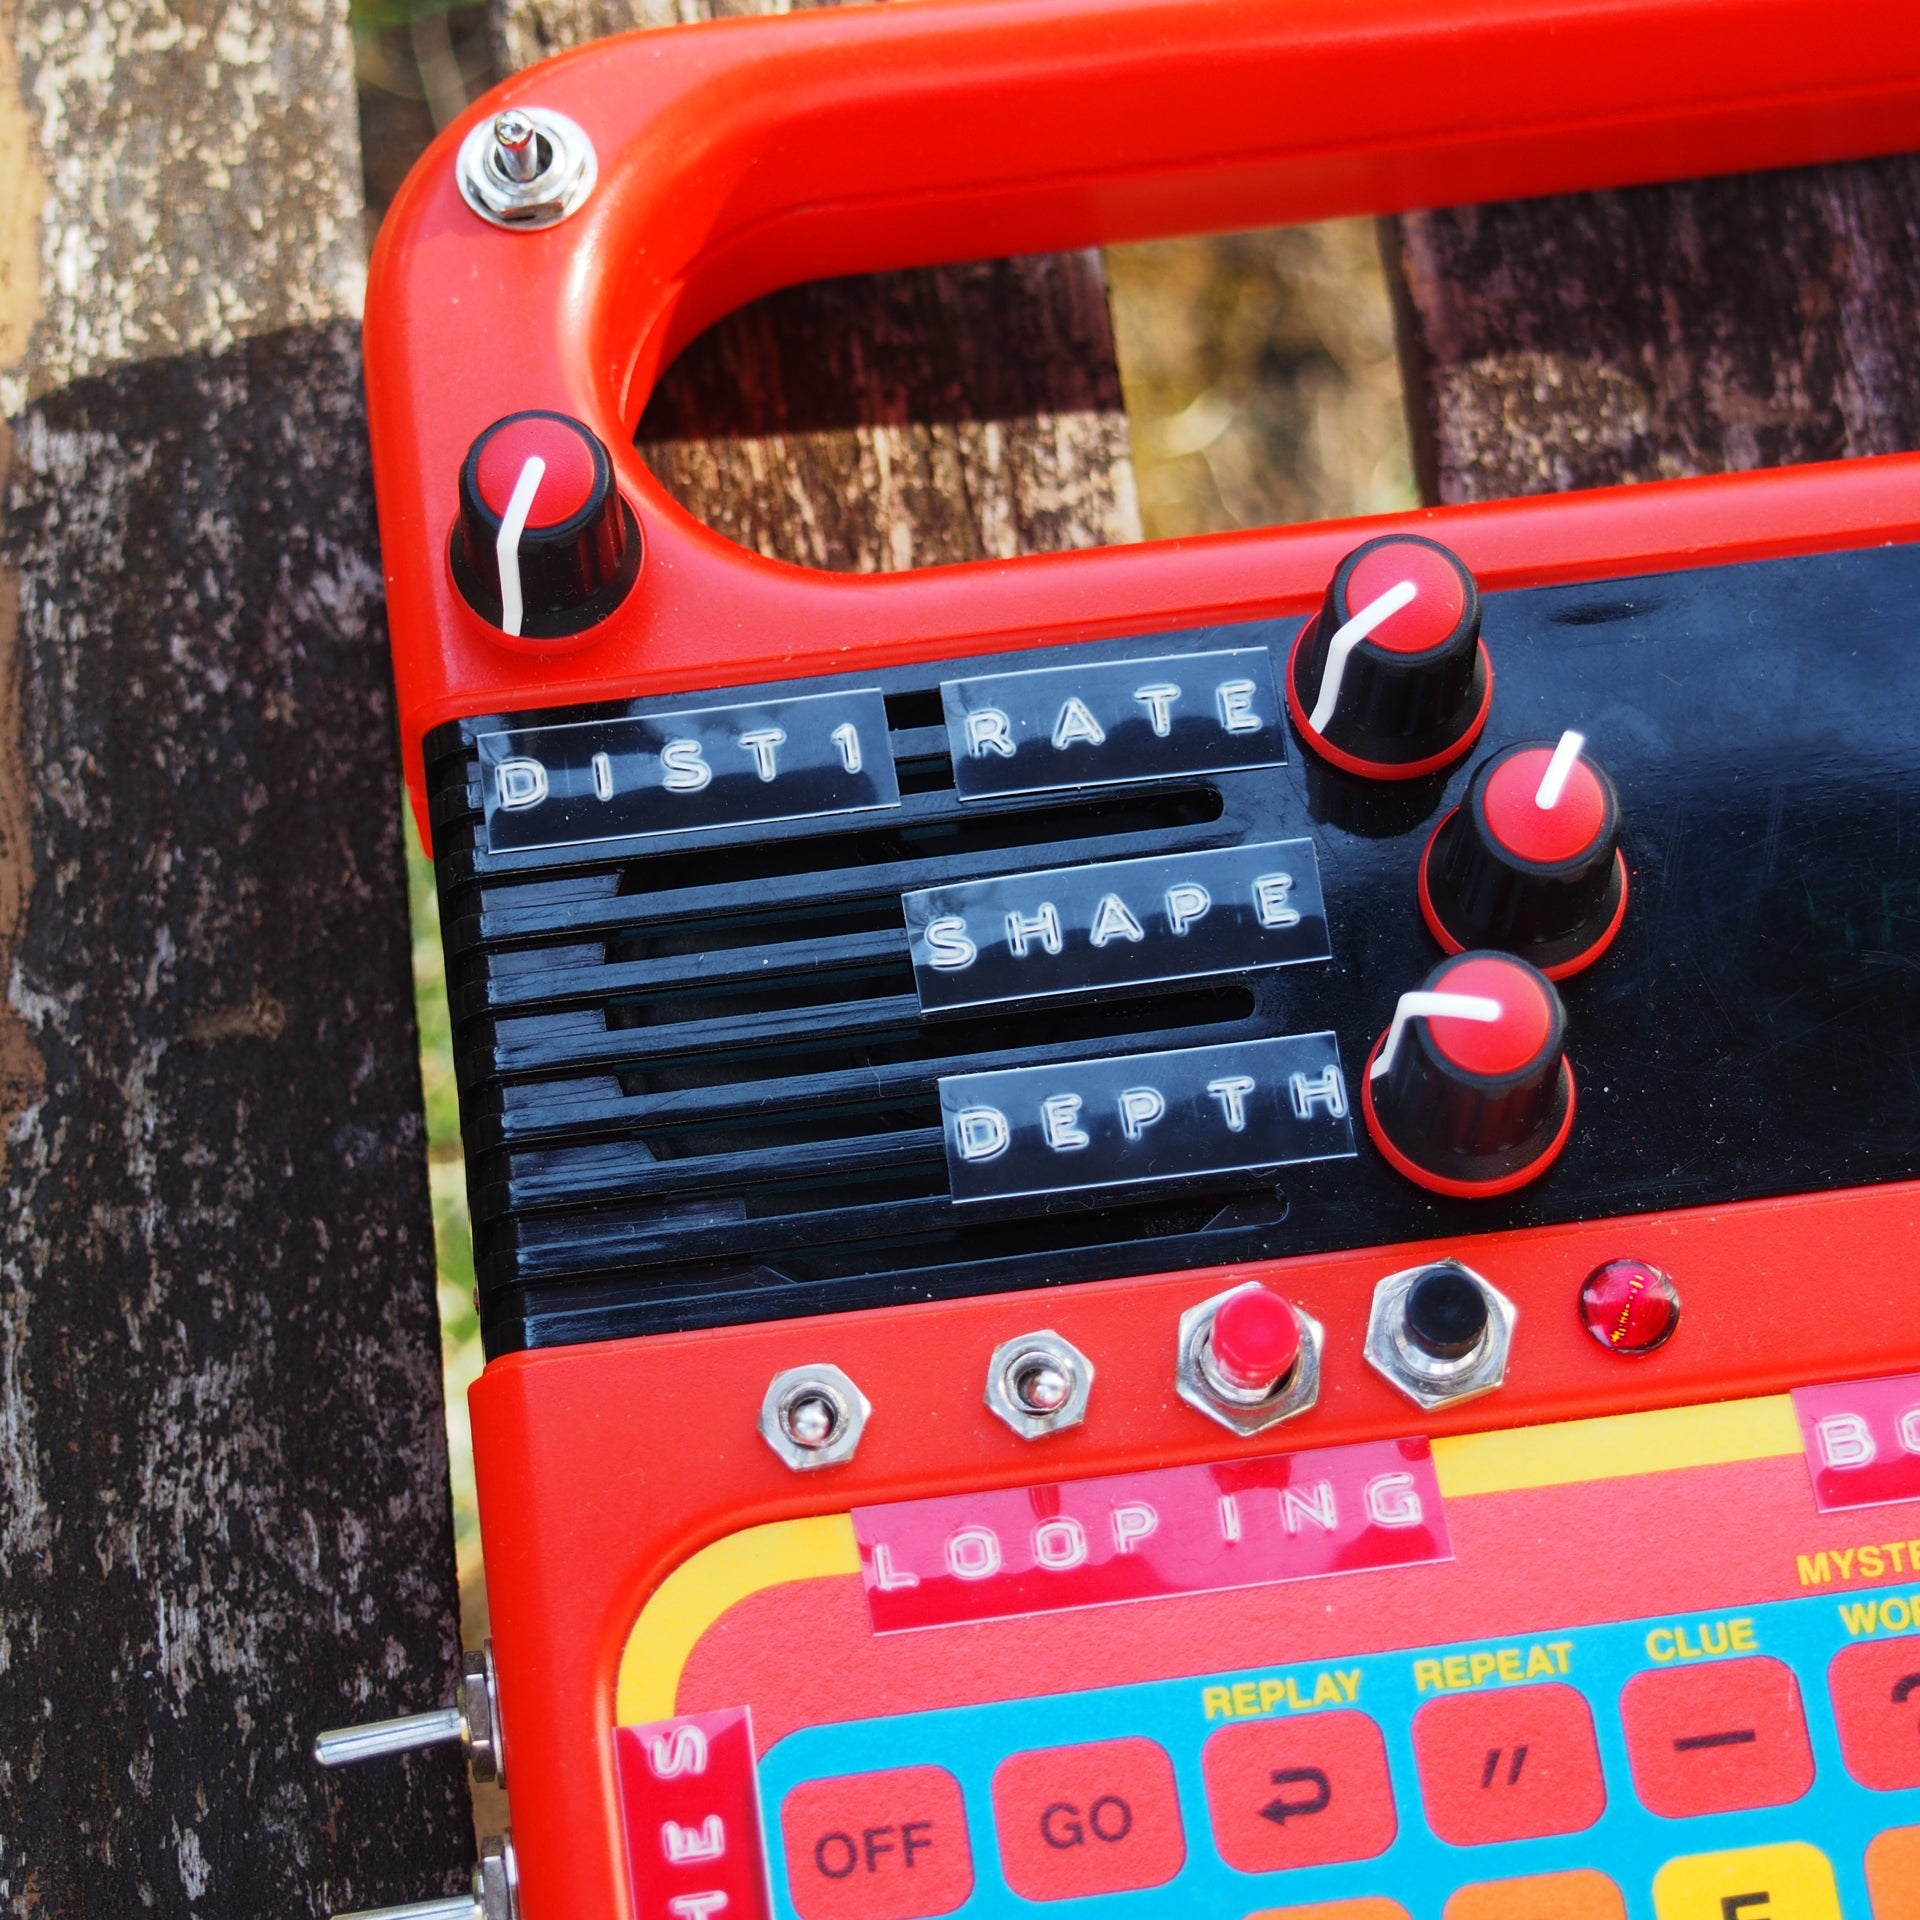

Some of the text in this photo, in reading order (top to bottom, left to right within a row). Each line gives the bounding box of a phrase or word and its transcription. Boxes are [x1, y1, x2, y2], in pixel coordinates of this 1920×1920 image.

[965, 678, 1265, 760] RATE
[923, 872, 1301, 972] SHAPE
[953, 1064, 1348, 1162] DEPTH
[871, 1472, 1424, 1592] LOOPING
[1414, 1641, 1574, 1692] REPEAT
[1645, 1617, 1758, 1662] CLUE
[1202, 1669, 1362, 1720] REPLAY
[814, 1820, 933, 1879] OFF
[1040, 1795, 1133, 1850] GO
